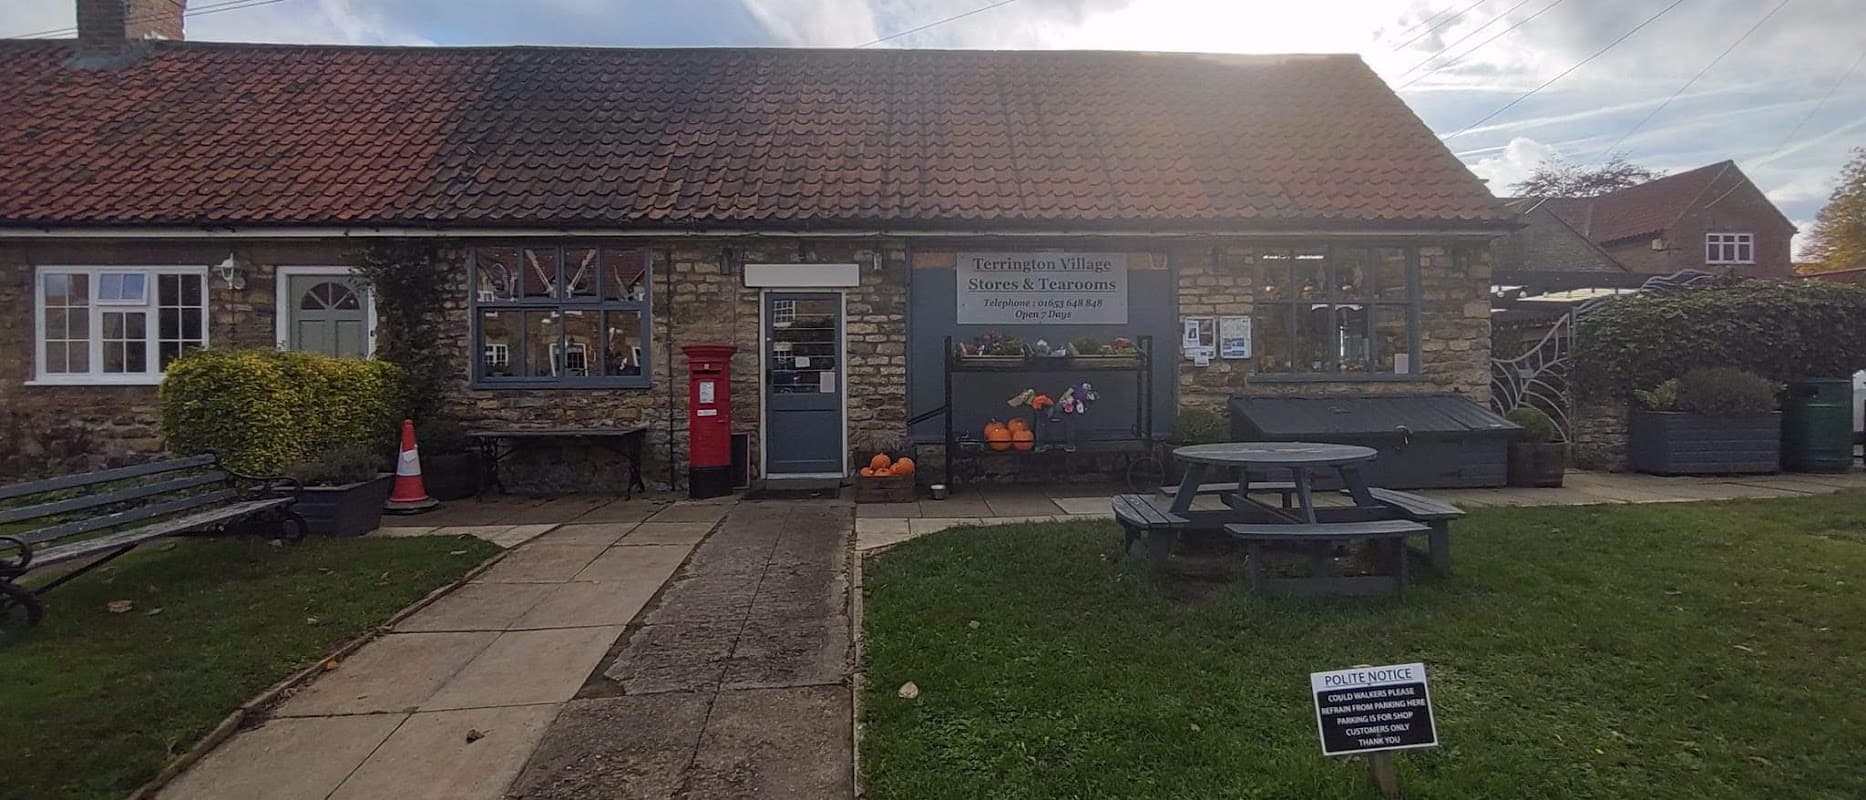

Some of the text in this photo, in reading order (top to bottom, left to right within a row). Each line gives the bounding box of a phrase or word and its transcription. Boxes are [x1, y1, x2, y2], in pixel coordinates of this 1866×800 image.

[972, 257, 1112, 273] Terrington Village
[968, 278, 1117, 291] Stores & Tearooms
[983, 298, 1030, 309] Telephone
[1037, 299, 1064, 309] 01653
[1066, 298, 1083, 307] 648
[1085, 298, 1103, 307] 848
[1015, 309, 1072, 320] Open 7 Days
[1325, 668, 1412, 686] POLITE NOTICE
[1327, 687, 1415, 703] COULD WALKERS PLEASE
[1321, 698, 1425, 715] REFRAIN FROM PARKING HERE
[1336, 716, 1369, 726] PARKING
[1377, 713, 1392, 721] FOR
[1393, 711, 1413, 720] SHOP
[1345, 723, 1410, 736] CUSTOMERS ONLY
[1358, 736, 1401, 747] THANK YOU
